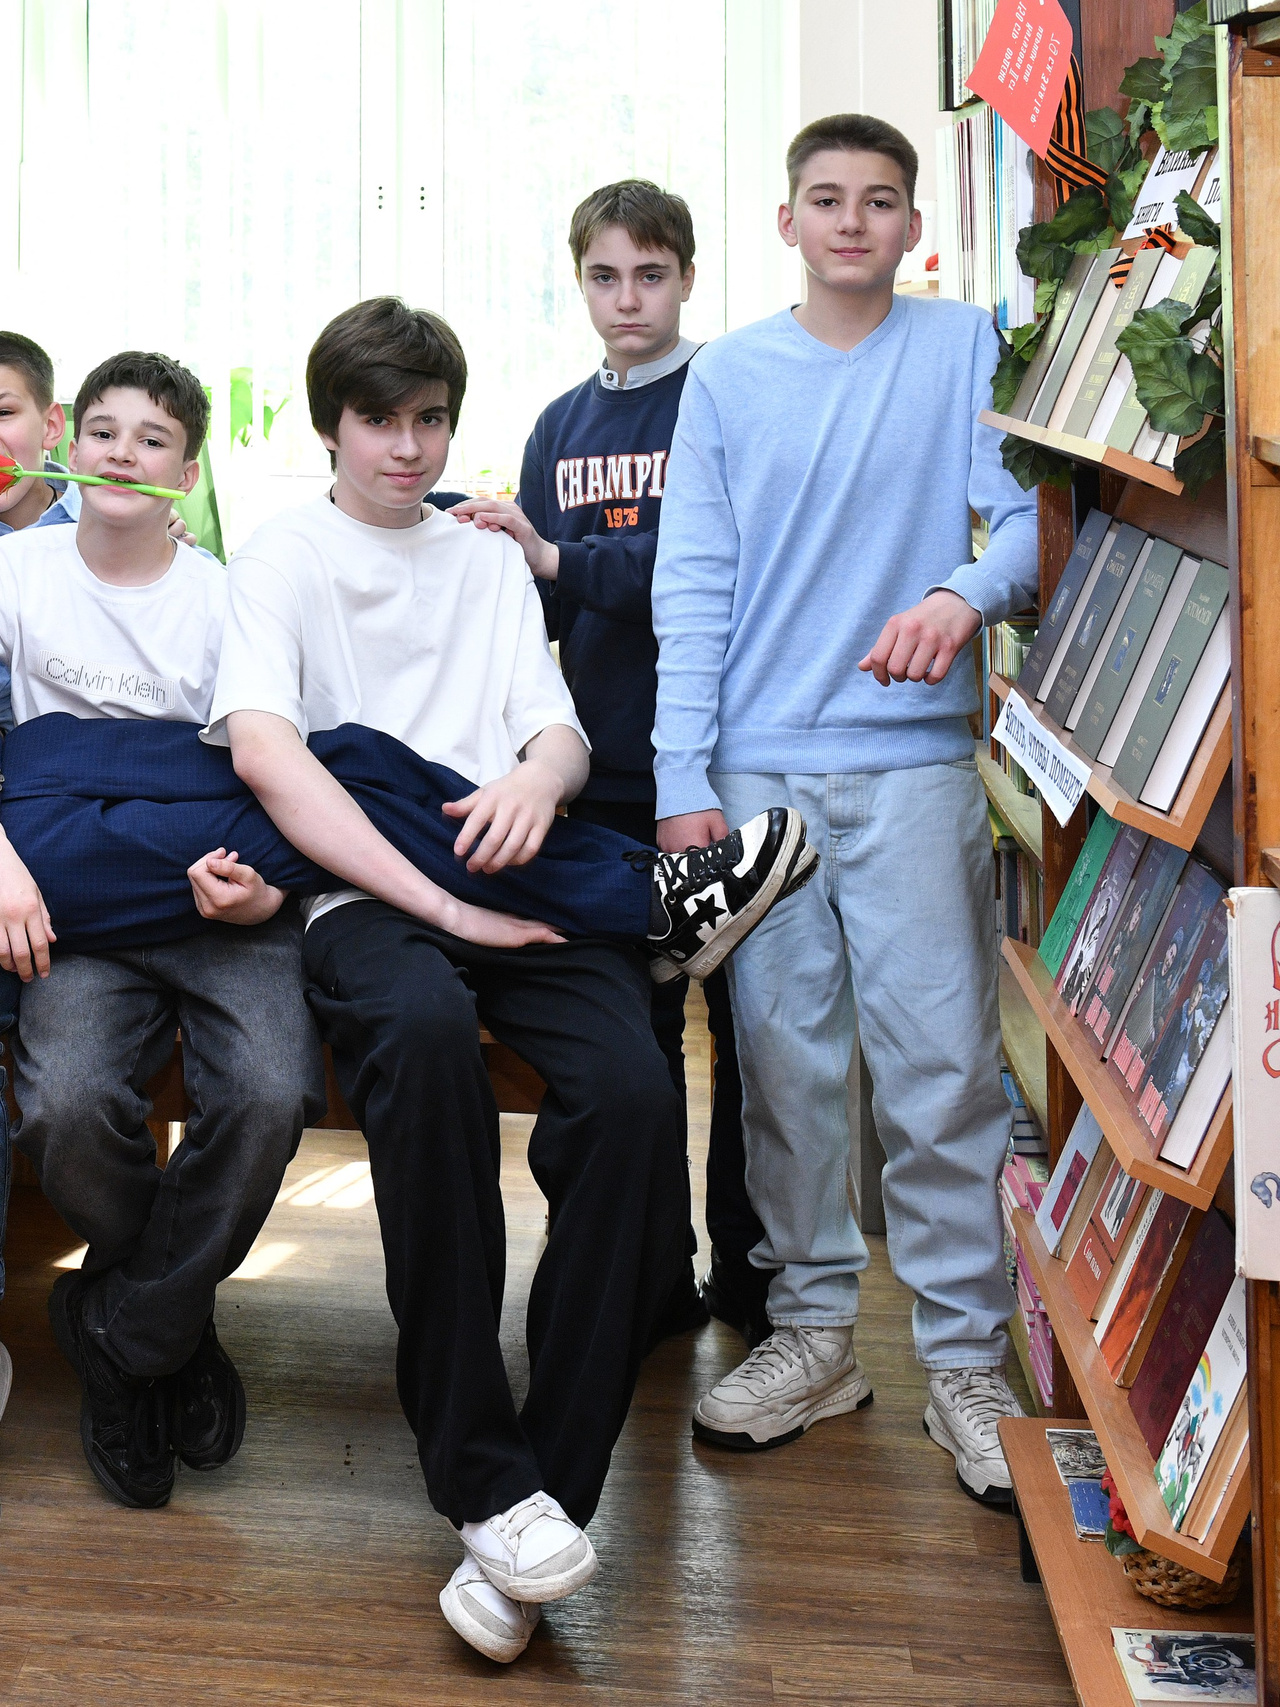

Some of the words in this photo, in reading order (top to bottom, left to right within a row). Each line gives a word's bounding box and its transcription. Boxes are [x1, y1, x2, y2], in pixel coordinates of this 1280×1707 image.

[555, 450, 670, 513] CHAMPI
[604, 505, 639, 529] 1976
[46, 657, 113, 692] Calvin
[118, 673, 166, 704] Klein
